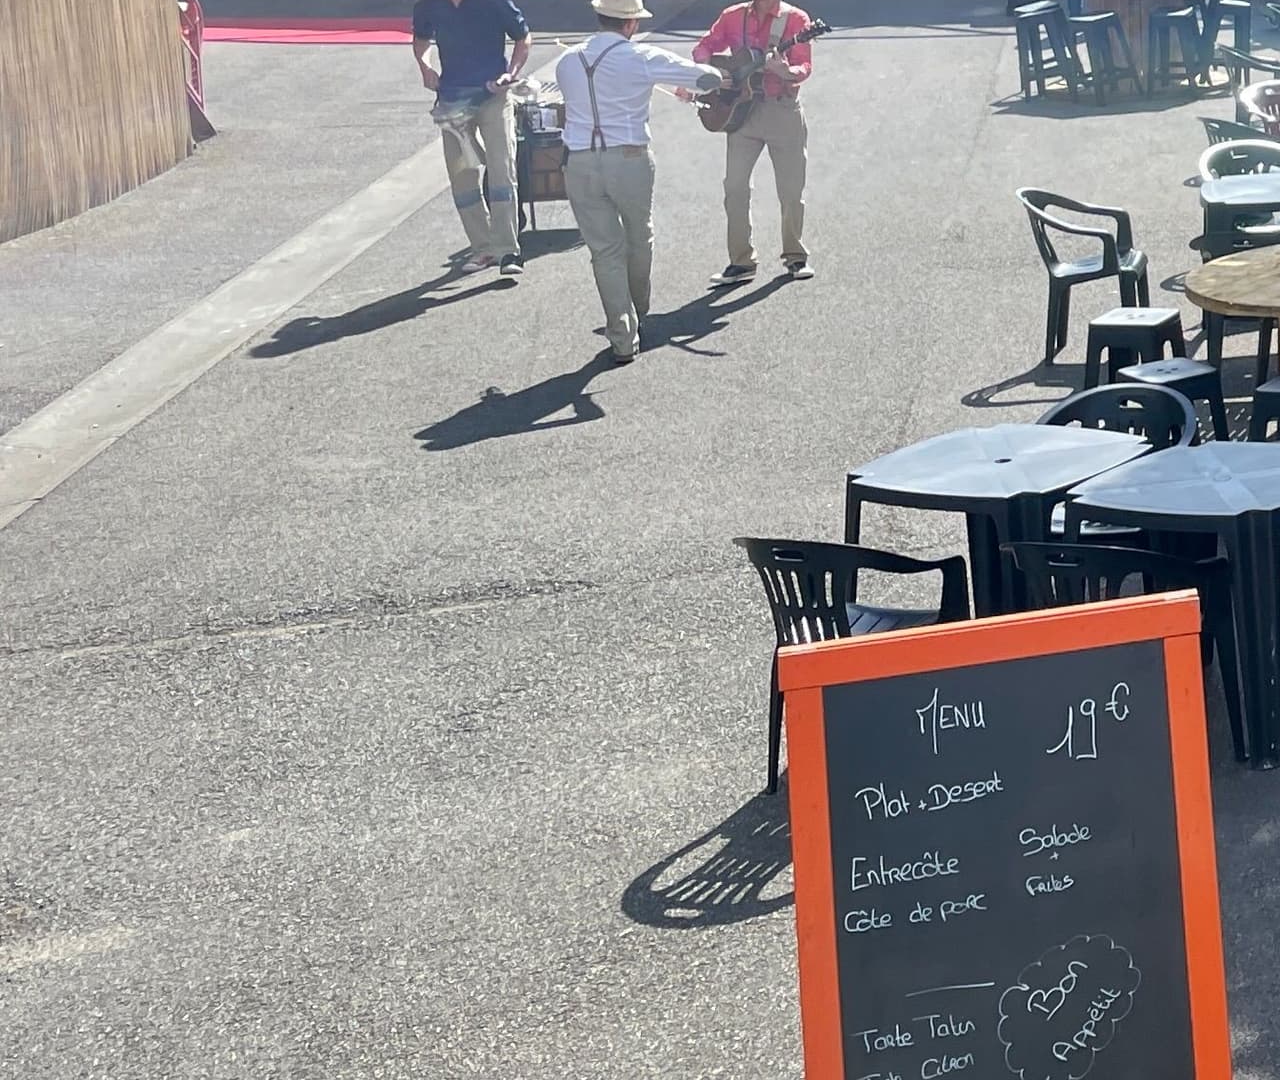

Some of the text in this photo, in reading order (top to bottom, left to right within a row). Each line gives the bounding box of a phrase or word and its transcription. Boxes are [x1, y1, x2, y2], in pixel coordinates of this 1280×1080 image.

[916, 687, 986, 755] MENU
[854, 782, 912, 821] Plat
[1019, 824, 1093, 857] Salade
[852, 851, 961, 892] Entrecôte
[844, 908, 893, 933] Côte
[909, 902, 933, 923] de
[1027, 961, 1089, 1022] Bon
